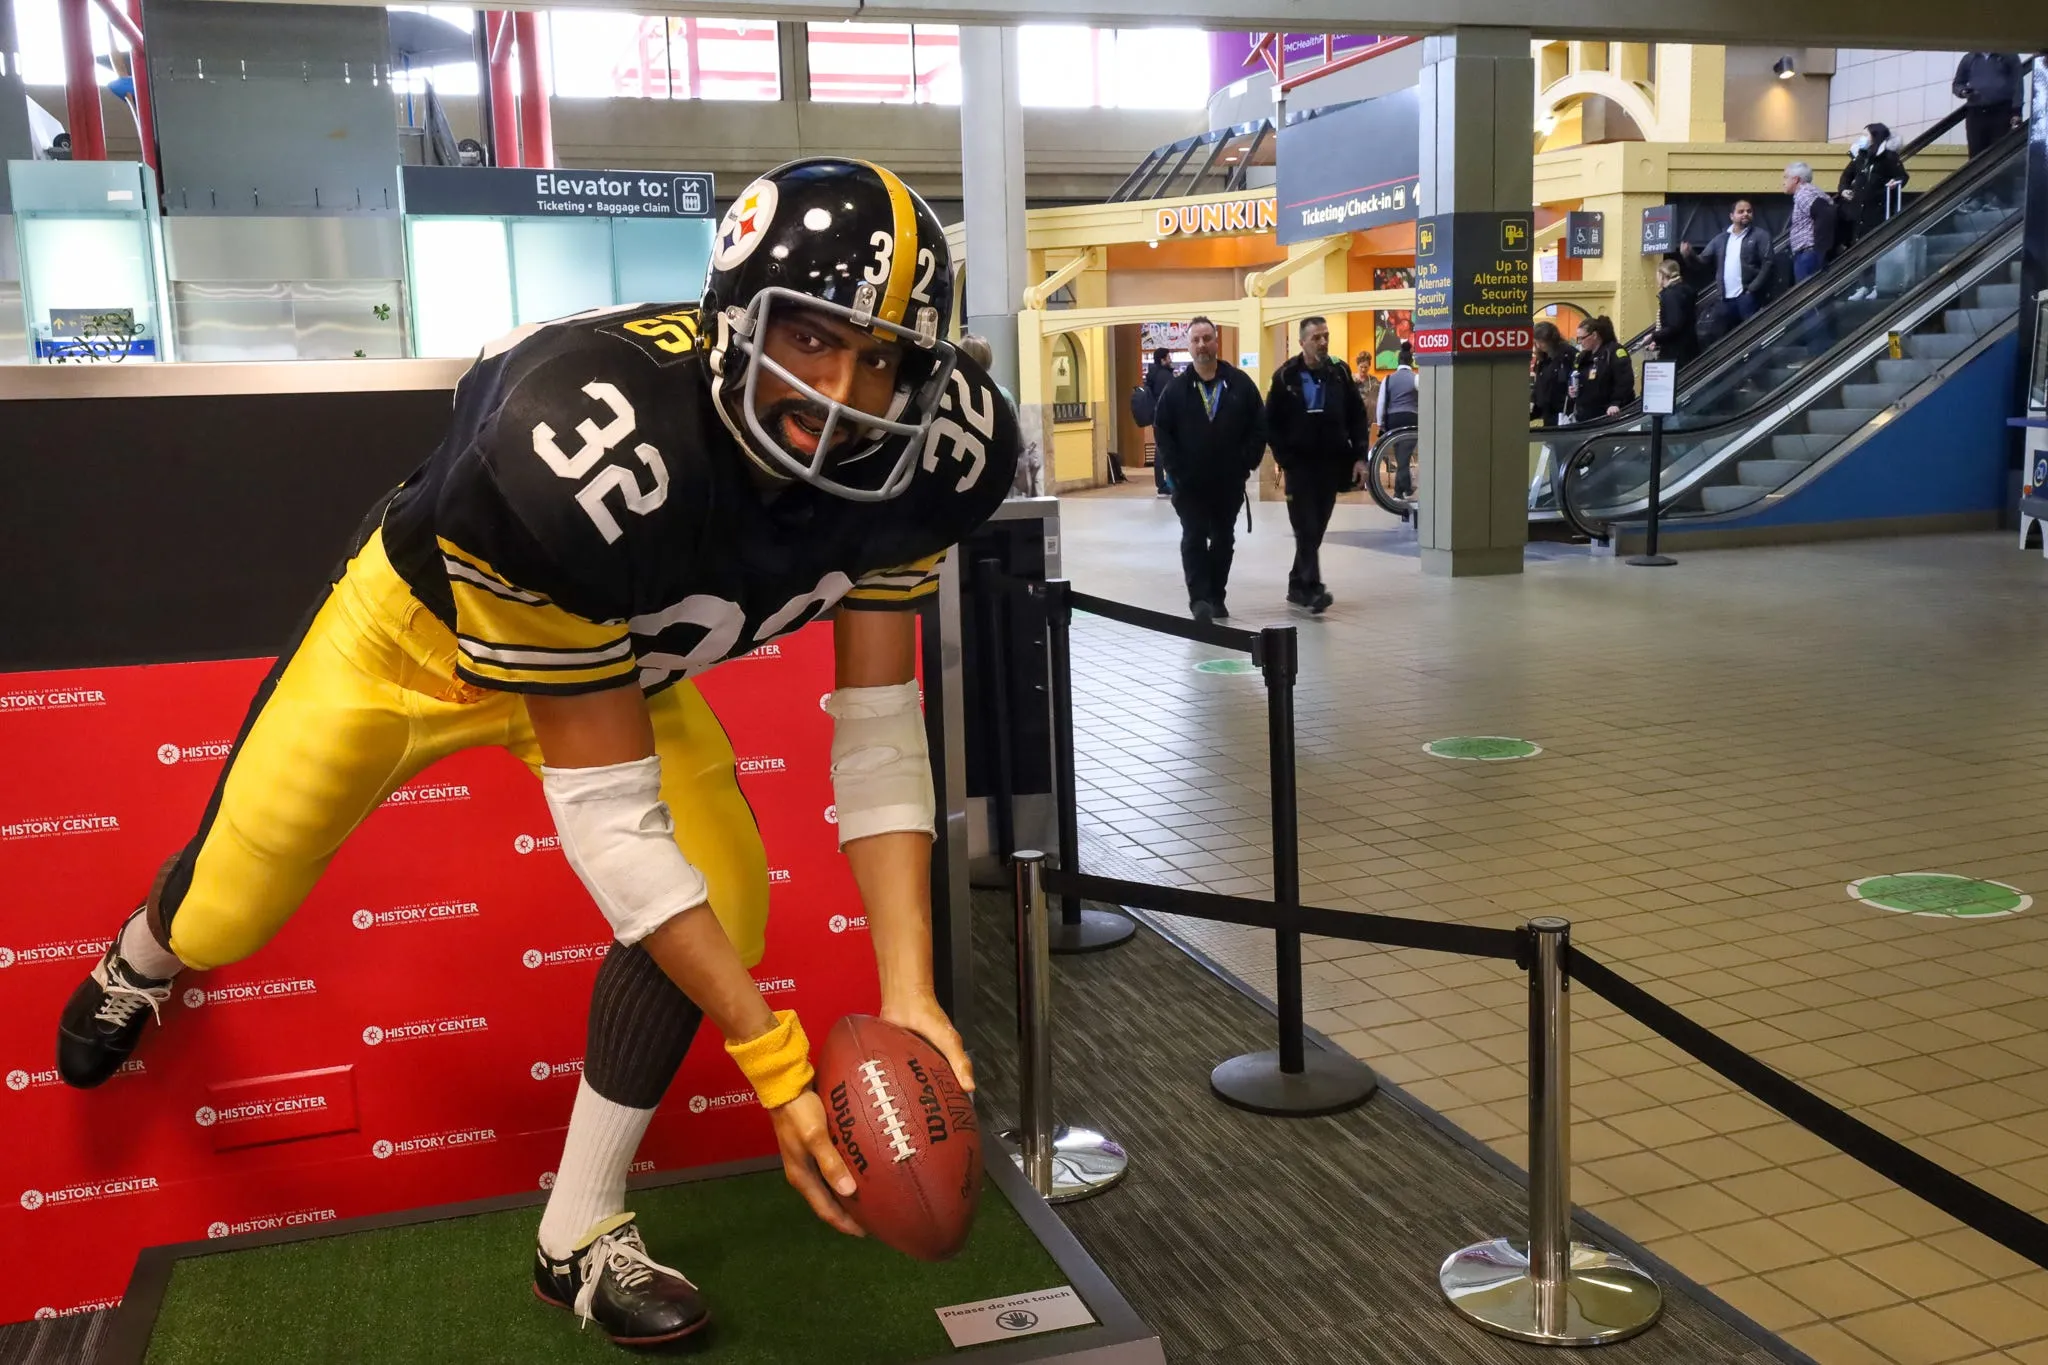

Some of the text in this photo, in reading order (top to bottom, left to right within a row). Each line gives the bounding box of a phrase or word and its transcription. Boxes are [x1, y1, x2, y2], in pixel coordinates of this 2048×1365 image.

[536, 174, 668, 198] Elevator to:
[536, 200, 670, 214] Ticketing Baggage Claim
[1301, 193, 1391, 227] Ticketing/Check-in
[1156, 198, 1277, 236] DUNKIN
[1573, 247, 1601, 256] Elevator
[1643, 242, 1669, 252] Elevator
[1418, 264, 1437, 277] Up To
[1496, 260, 1512, 274] Up
[1515, 260, 1528, 271] To
[1418, 276, 1451, 290] Alternate
[1474, 273, 1528, 285] Alternate
[1418, 292, 1446, 305] Security
[1482, 288, 1528, 302] Security
[1418, 306, 1449, 317] Checkpoint
[1464, 303, 1528, 317] Checkpoint
[1418, 334, 1449, 348] CLOSED
[1460, 330, 1529, 348] CLOSED
[532, 382, 670, 545] 32
[48, 691, 105, 704] CENTER
[740, 758, 786, 771] CENTER
[420, 786, 470, 800] CENTER
[2, 816, 119, 836] HISTORY CENTER
[376, 903, 478, 922] HISTORY CENTER
[17, 946, 74, 960] HISTORY
[544, 947, 593, 962] HISTORY
[208, 986, 260, 1001] HISTORY
[264, 980, 315, 994] CENTER
[386, 1017, 487, 1038] HISTORY CENTER
[709, 1092, 755, 1107] HISTORY
[907, 1058, 948, 1145] Wilson
[219, 1104, 272, 1119] HISTORY
[275, 1097, 326, 1112] CENTER
[830, 1080, 869, 1175] Wilson
[395, 1136, 444, 1152] HISTORY
[448, 1129, 496, 1144] CENTER
[46, 1177, 158, 1202] HISTORY CENTER
[231, 1209, 336, 1233] HISTORY CENTER
[943, 1291, 1070, 1318] Please do not touch
